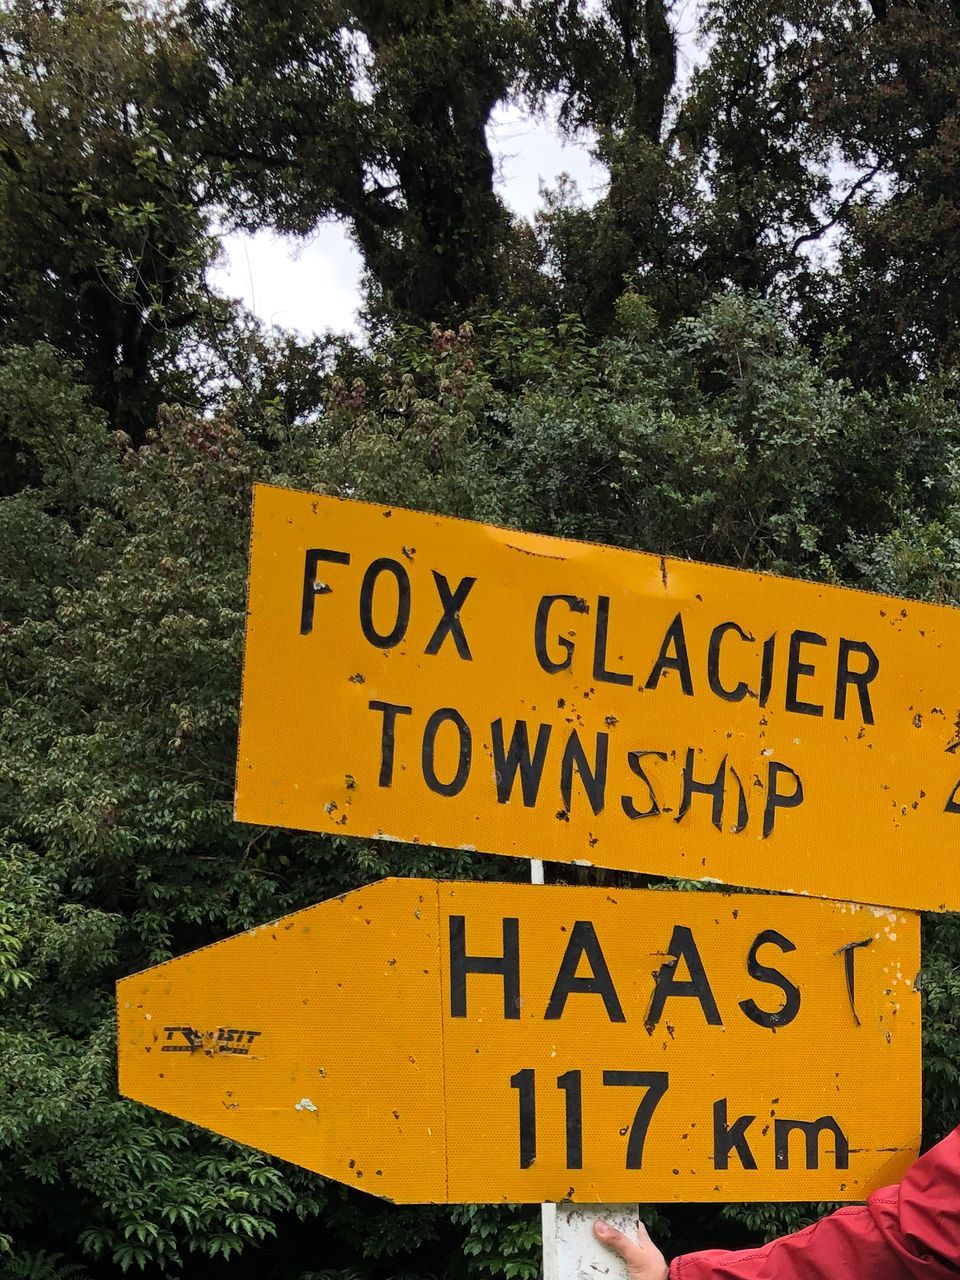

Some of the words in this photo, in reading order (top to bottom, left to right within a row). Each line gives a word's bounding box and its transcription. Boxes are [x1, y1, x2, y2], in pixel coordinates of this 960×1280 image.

[300, 548, 477, 661] FOX
[534, 594, 880, 725] GLACIER
[368, 699, 804, 840] TOWNSHIP
[448, 914, 873, 1030] HAAST
[510, 1067, 670, 1171] 117
[712, 1097, 850, 1171] km
